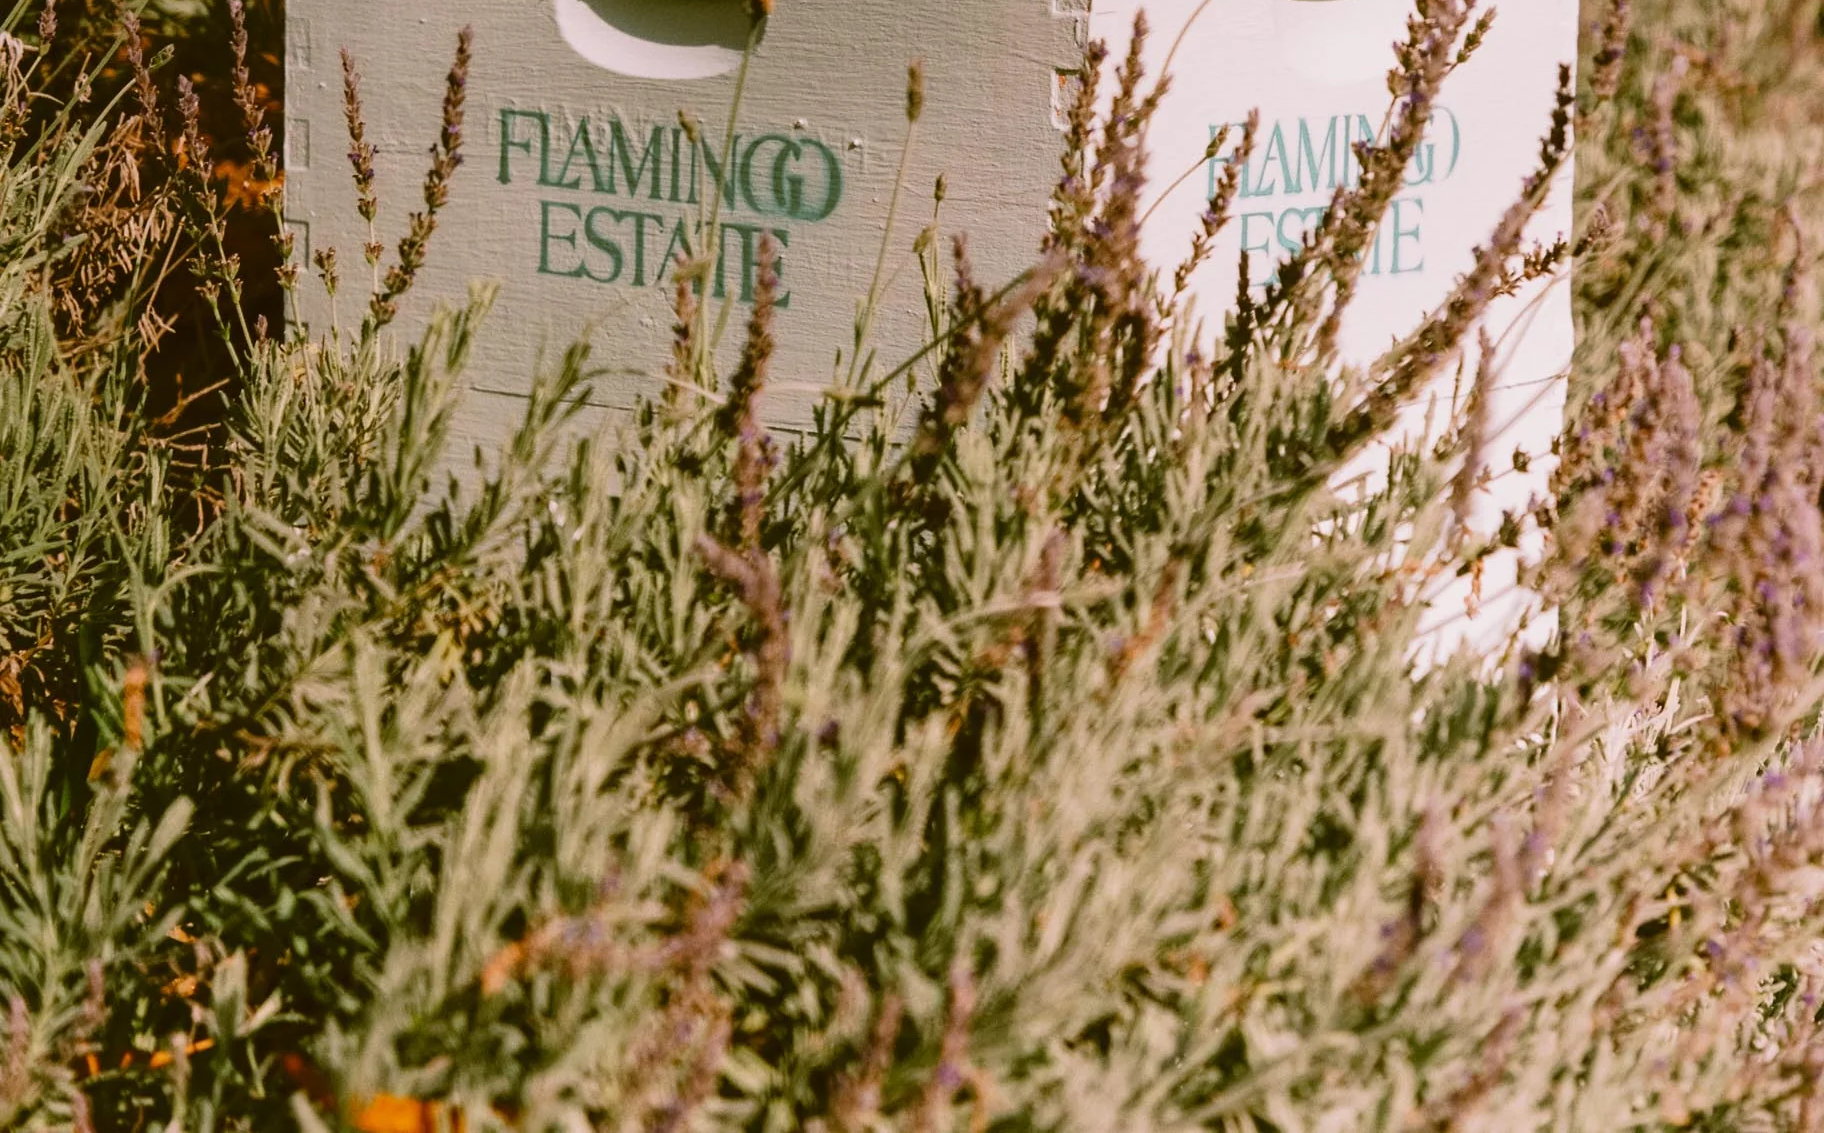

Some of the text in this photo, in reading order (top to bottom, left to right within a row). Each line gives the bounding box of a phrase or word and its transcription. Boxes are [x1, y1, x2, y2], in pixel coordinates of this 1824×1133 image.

[496, 107, 843, 222] FLAMINGO
[536, 199, 792, 308] ESTATE
[1240, 197, 1425, 287] ESE
